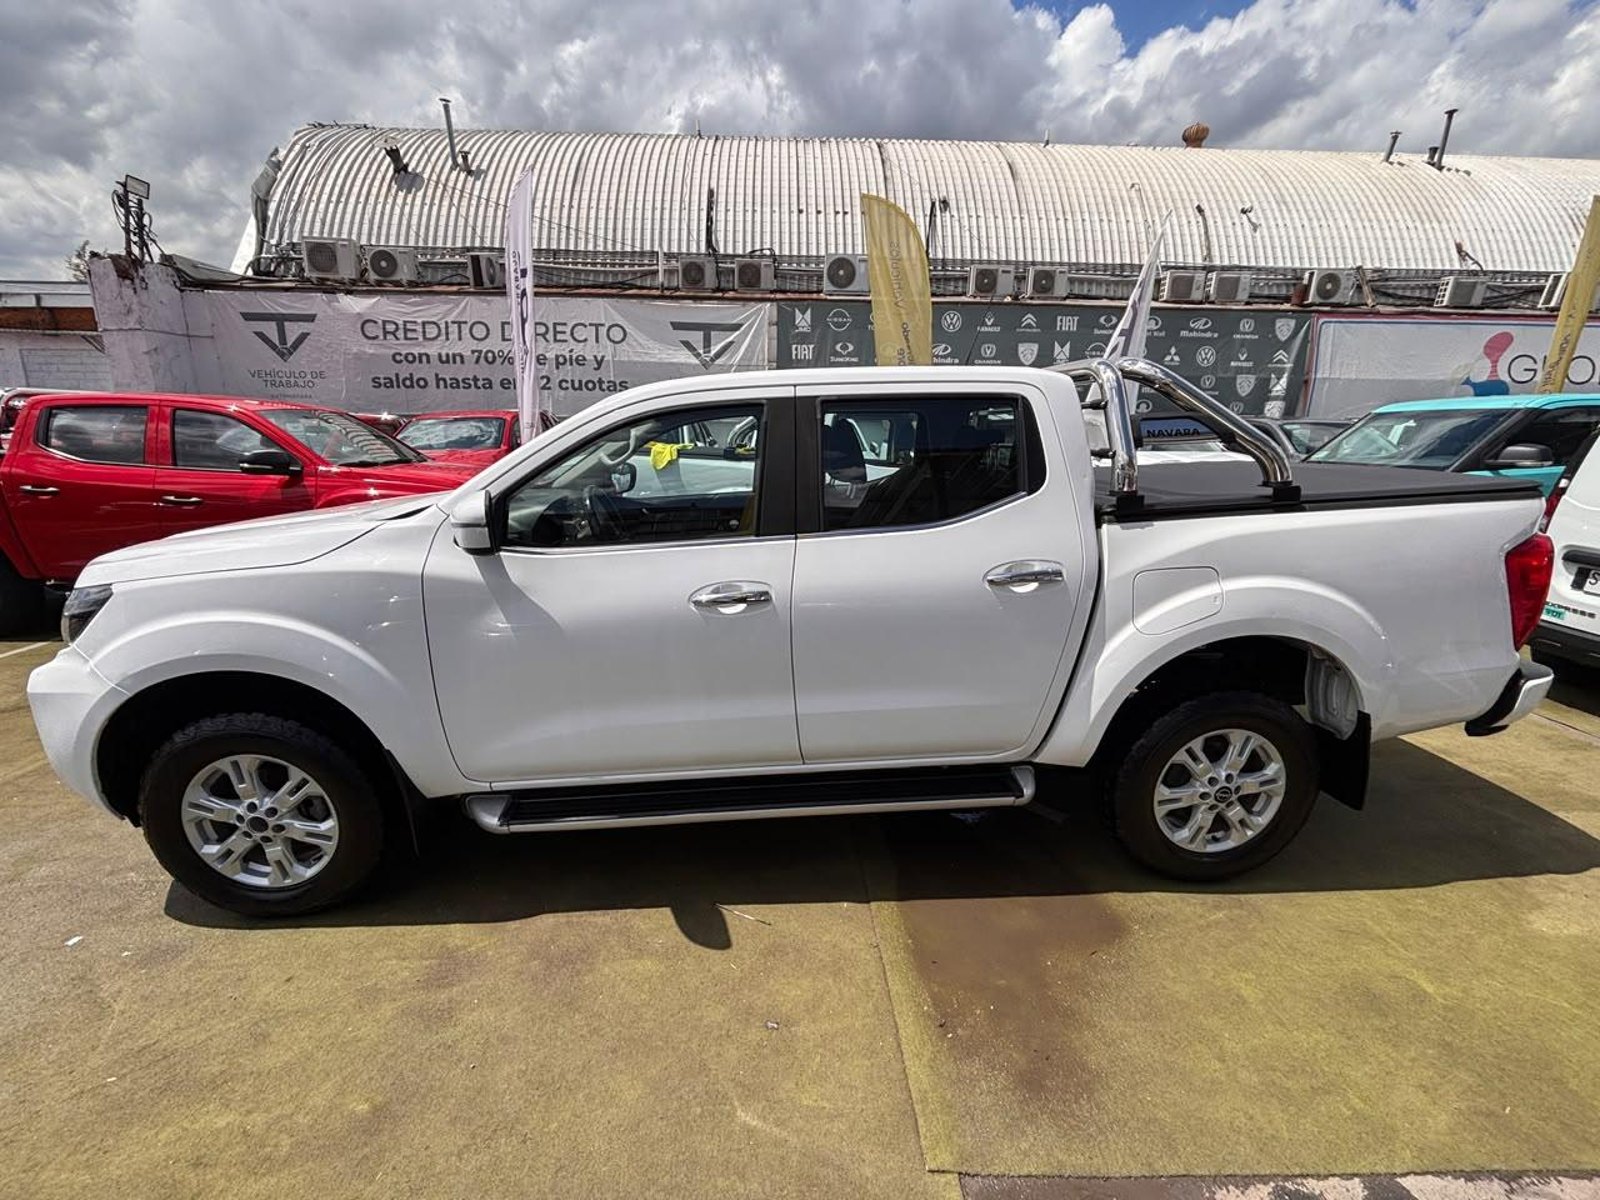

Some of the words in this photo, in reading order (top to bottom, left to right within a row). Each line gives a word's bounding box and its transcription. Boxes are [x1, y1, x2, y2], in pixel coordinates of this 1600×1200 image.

[1056, 316, 1080, 331] FIAT
[360, 319, 491, 342] CREDITO
[501, 321, 628, 344] DRECTO
[1179, 330, 1219, 338] Mahindra
[392, 350, 430, 365] con
[437, 351, 465, 365] un
[471, 349, 515, 365] 70%
[554, 350, 590, 369] pie
[593, 355, 606, 369] y
[791, 344, 815, 360] FIAT
[310, 370, 327, 379] DE
[263, 379, 315, 389] TRABAJO
[372, 373, 429, 389] saldo
[435, 373, 494, 390] hasta
[558, 377, 629, 392] cuotas
[1146, 428, 1201, 438] NAVARA
